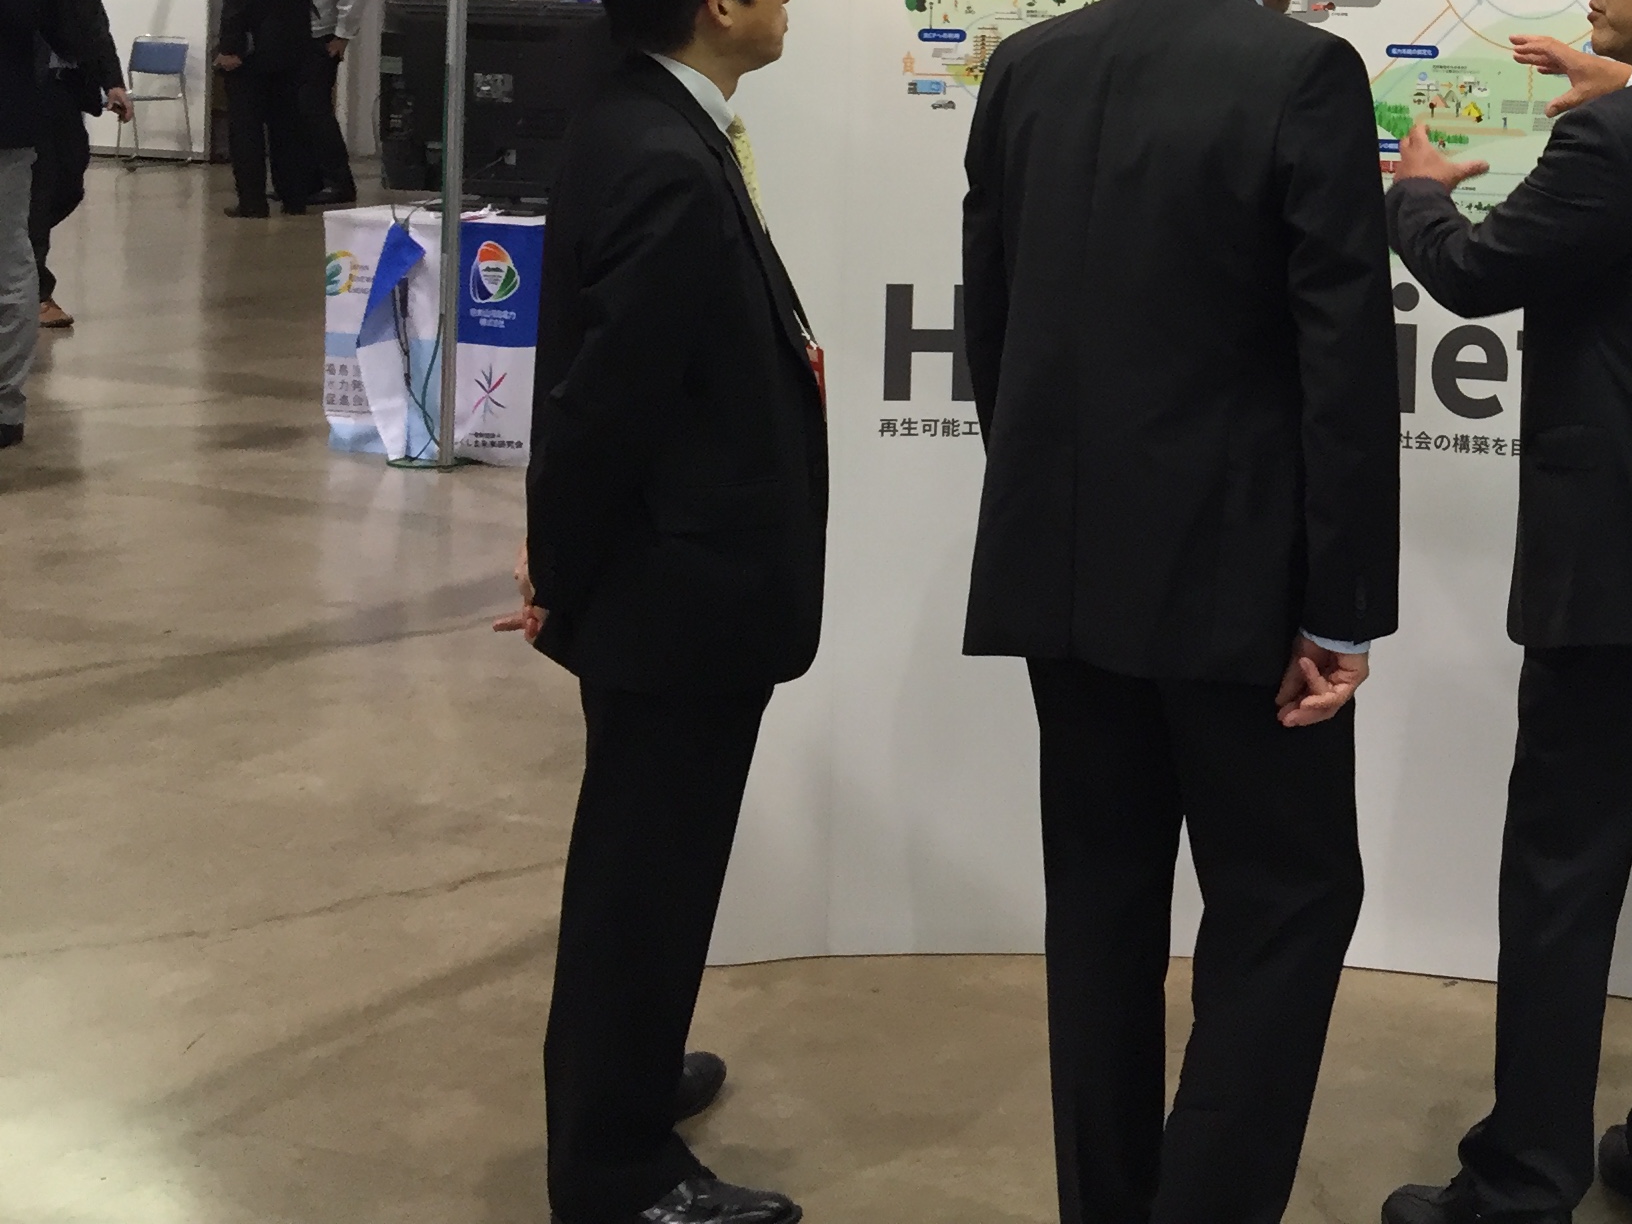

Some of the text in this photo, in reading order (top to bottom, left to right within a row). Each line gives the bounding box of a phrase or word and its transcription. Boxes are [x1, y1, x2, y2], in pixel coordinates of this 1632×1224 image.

[1392, 282, 1524, 419] ie
[878, 417, 981, 438] 再生可能エ
